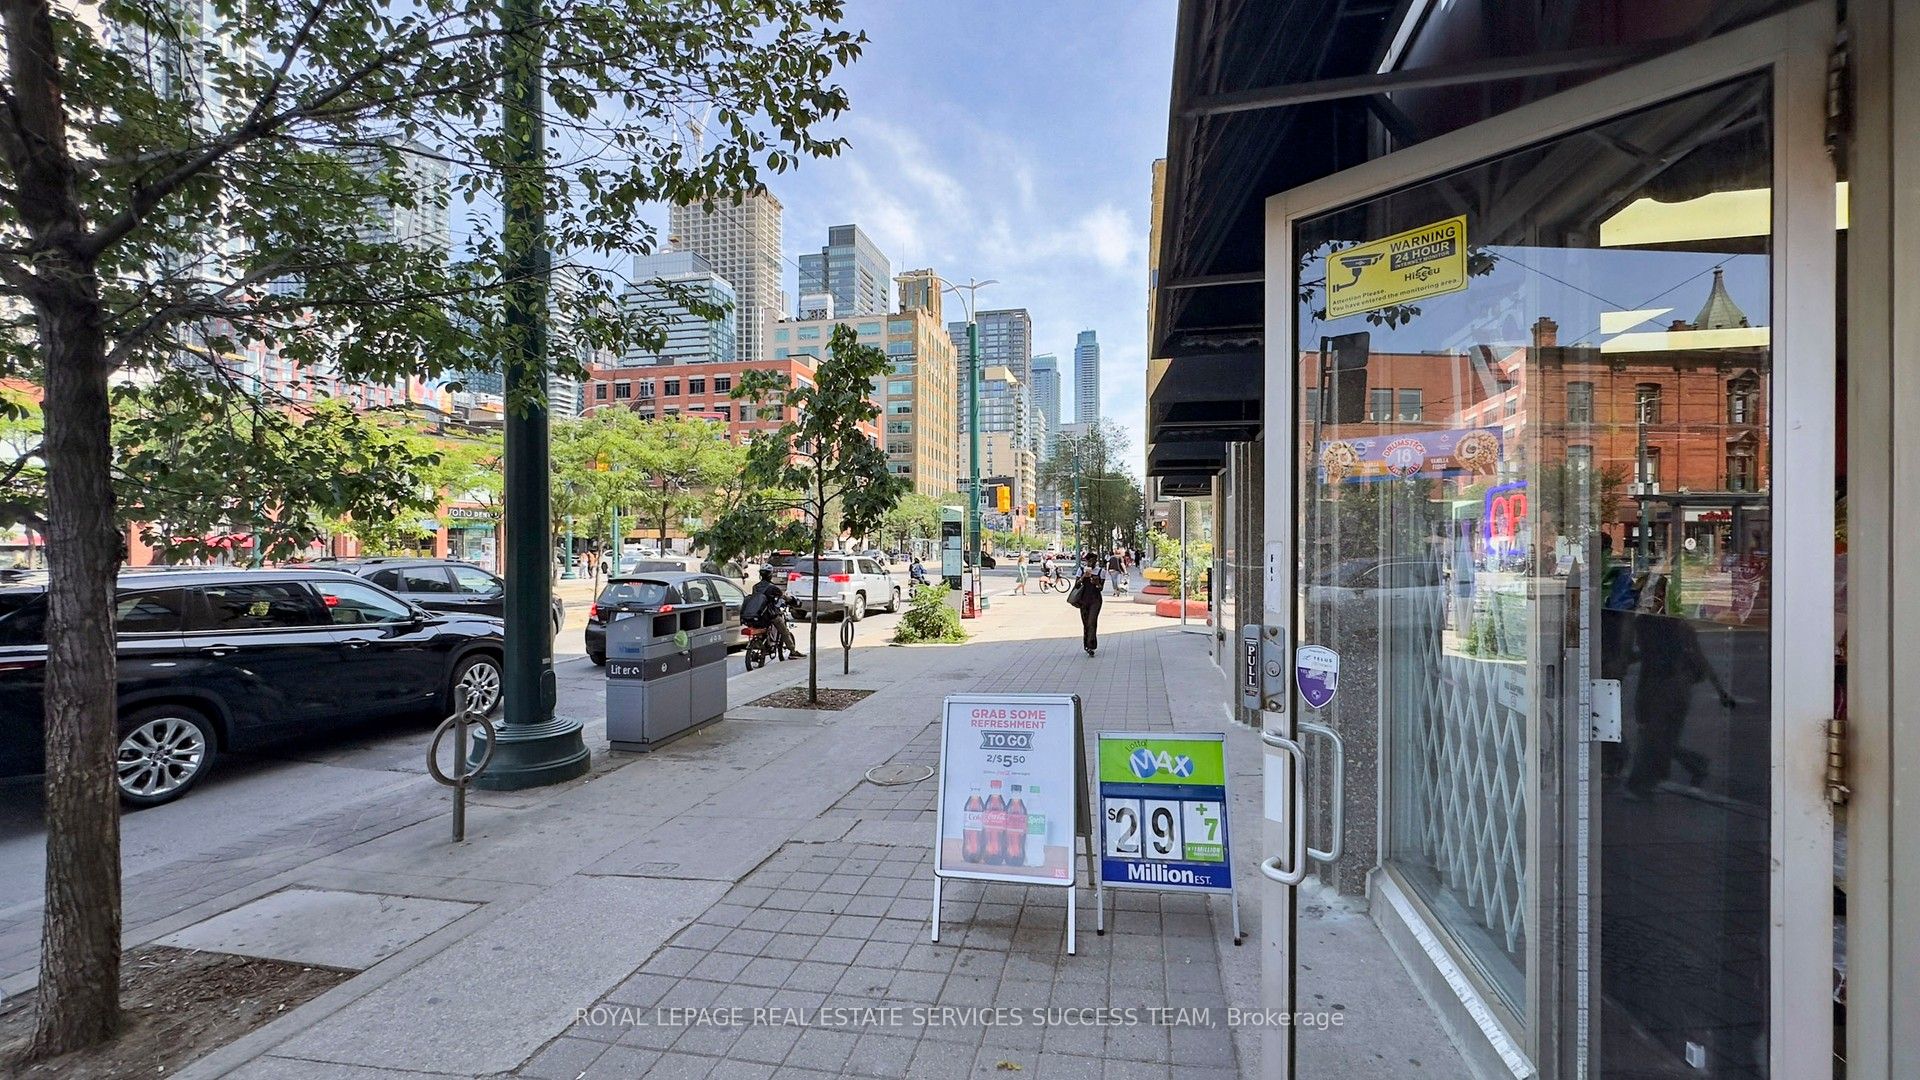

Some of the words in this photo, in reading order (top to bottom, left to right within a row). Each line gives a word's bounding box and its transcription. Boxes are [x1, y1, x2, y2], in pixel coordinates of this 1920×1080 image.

[1390, 227, 1455, 253] WARNING
[1395, 252, 1409, 264] 24
[1412, 241, 1450, 259] HOUR
[1424, 250, 1450, 261] MONITOR
[1333, 304, 1344, 312] You
[1345, 301, 1360, 309] have
[1361, 295, 1387, 304] entered
[1387, 292, 1398, 300] the
[1400, 283, 1439, 297] monitoring
[1440, 278, 1460, 287] area.
[1333, 292, 1361, 305] Attention
[1362, 288, 1386, 298] Please.
[1384, 440, 1425, 456] DRUMSTICK
[1248, 645, 1256, 686] PULL
[971, 709, 1006, 719] GRAB
[1010, 710, 1046, 720] SOME
[971, 720, 1046, 729] REFRESHMENT
[988, 734, 1005, 746] TO
[1007, 735, 1027, 747] GO
[1128, 863, 1194, 884] Million
[1195, 876, 1212, 885] EST.
